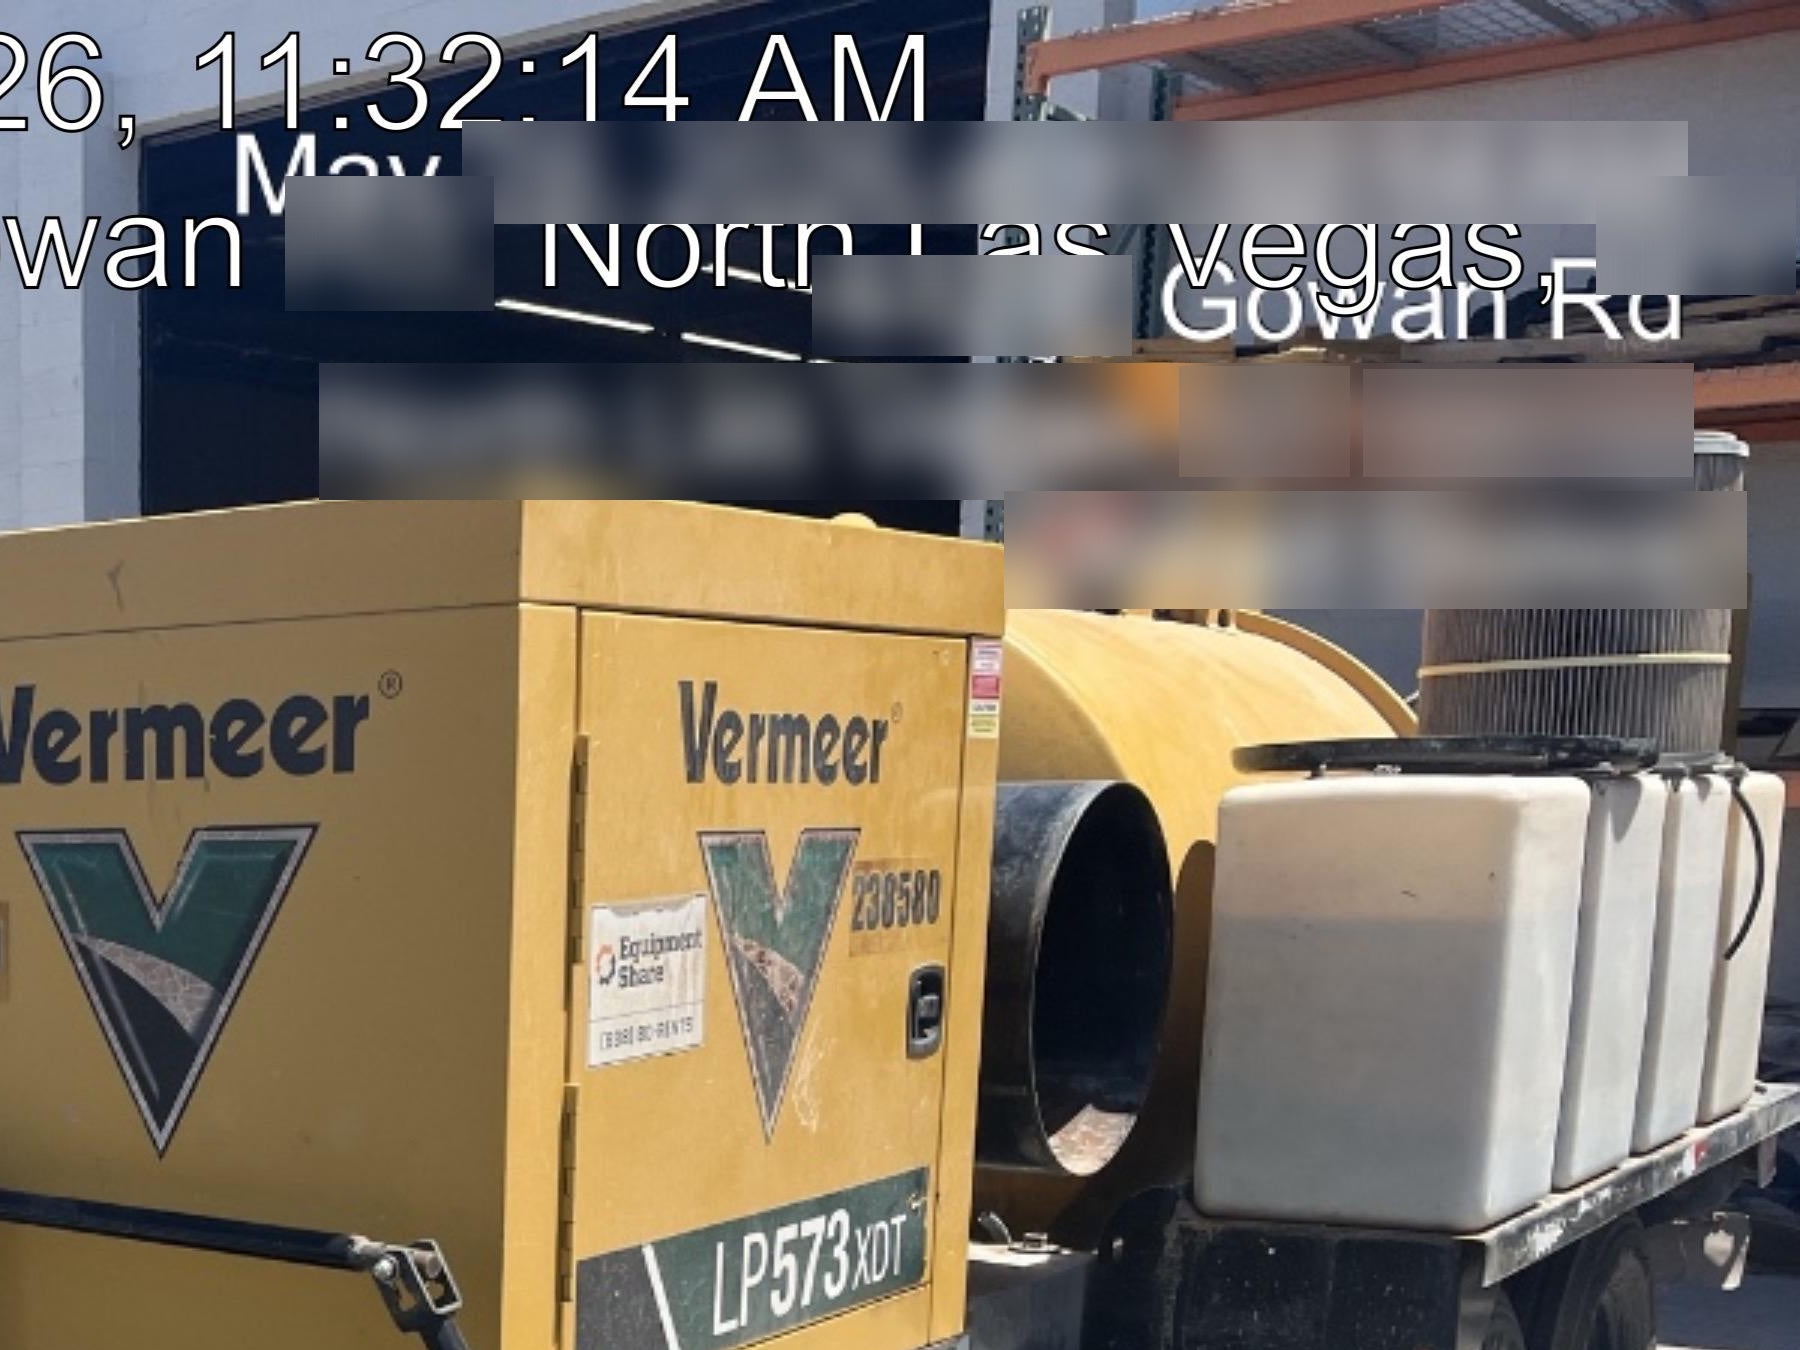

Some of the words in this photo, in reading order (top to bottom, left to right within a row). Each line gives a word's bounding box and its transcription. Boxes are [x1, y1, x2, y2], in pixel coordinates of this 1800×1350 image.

[678, 679, 890, 786] Vermeer
[620, 930, 703, 963] Equipment
[618, 965, 664, 989] Share
